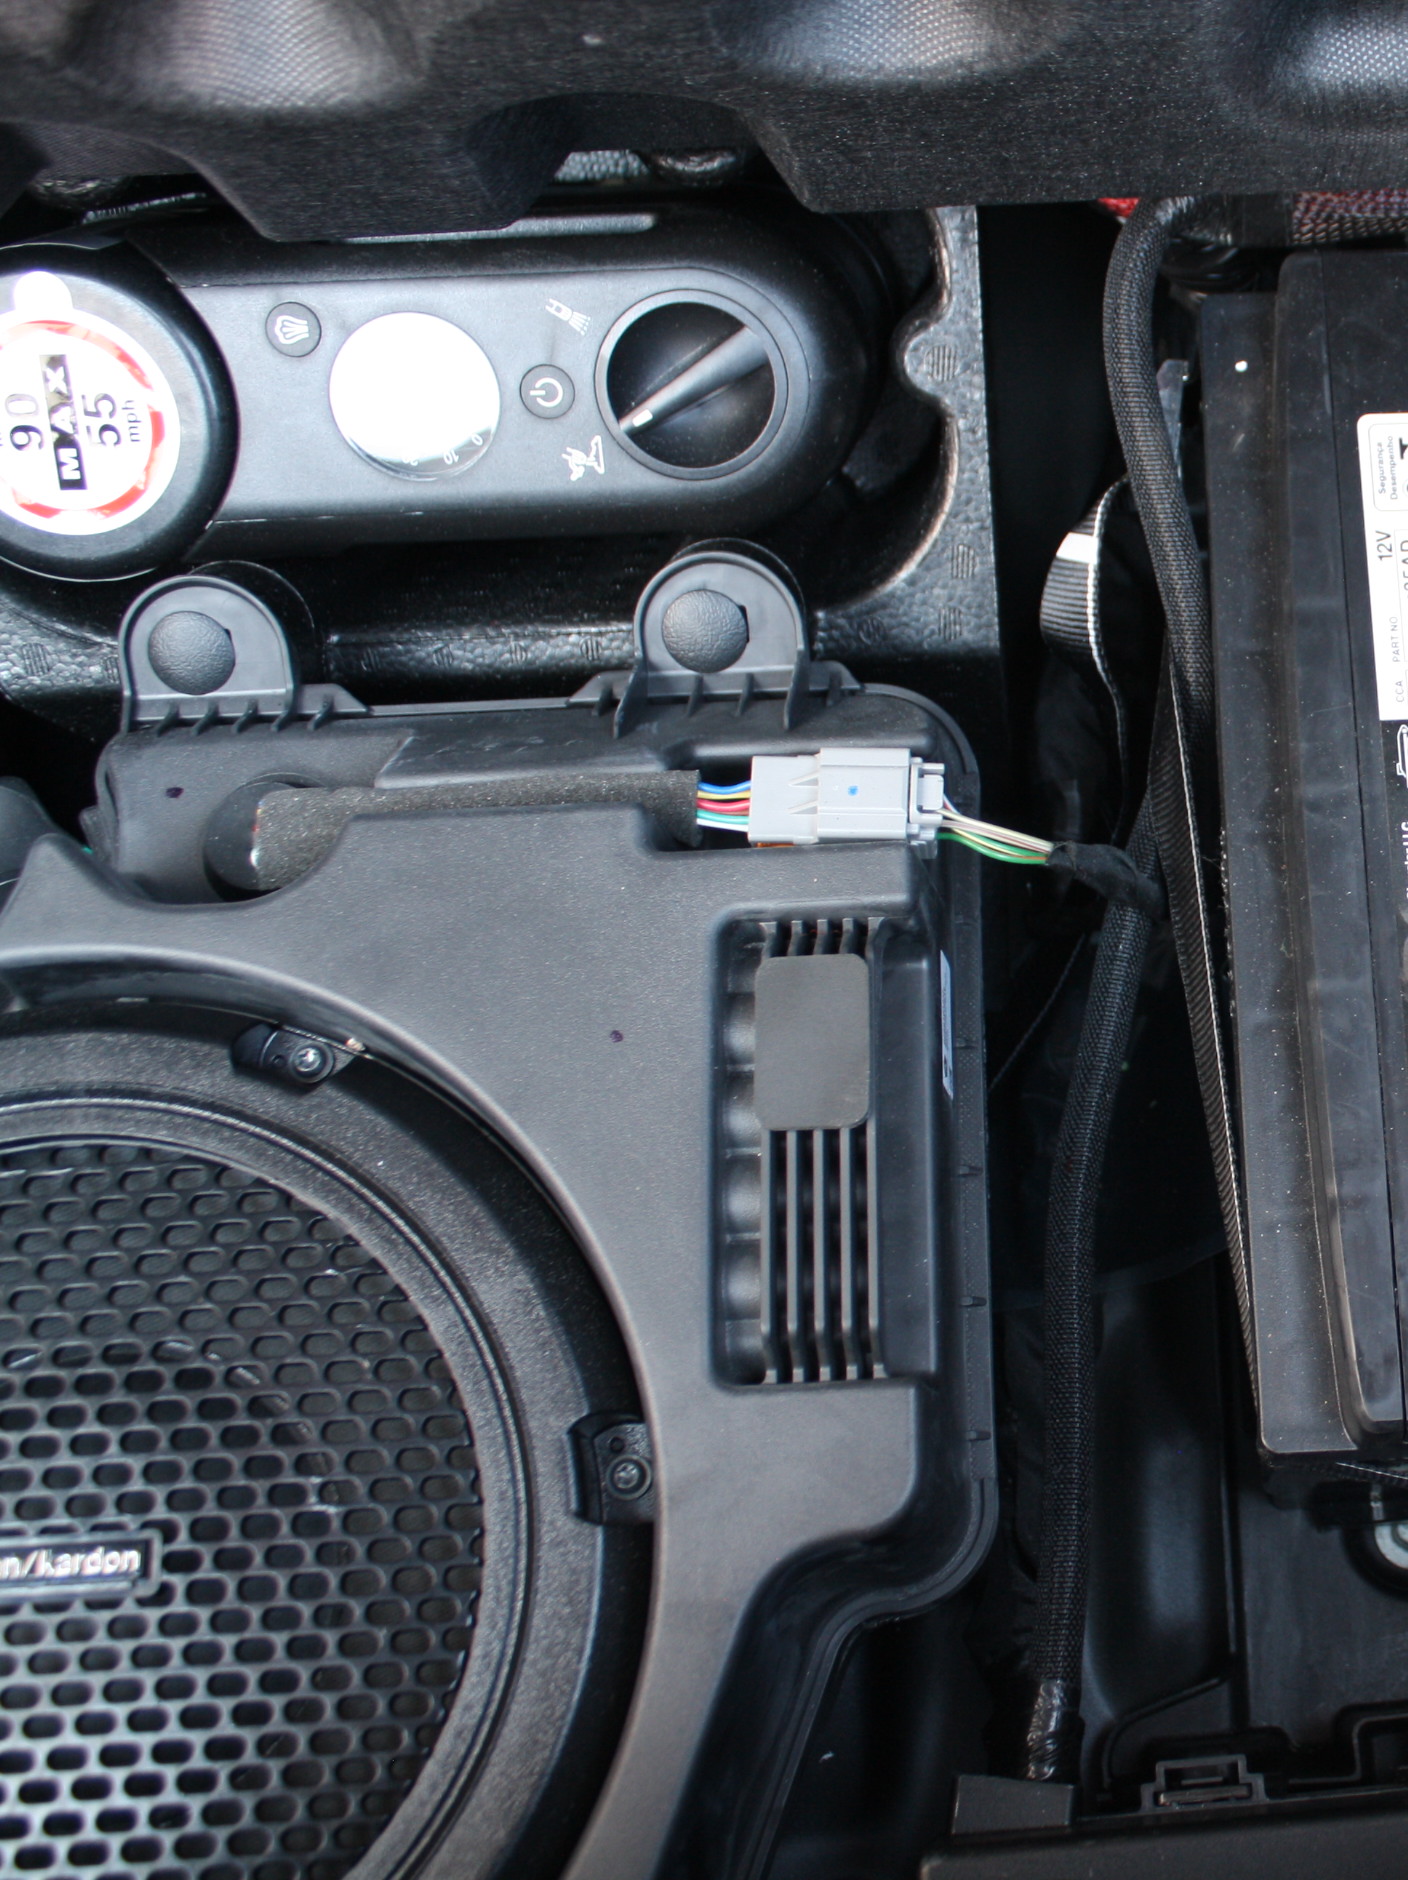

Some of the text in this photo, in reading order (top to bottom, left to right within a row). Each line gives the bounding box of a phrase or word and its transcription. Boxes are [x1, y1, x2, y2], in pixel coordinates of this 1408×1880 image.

[5, 393, 45, 452] 90
[45, 364, 83, 481] MAX
[81, 392, 122, 448] 55
[121, 400, 142, 443] mph
[1377, 442, 1386, 493] Segurança
[1387, 436, 1397, 499] Desempenho
[1375, 530, 1392, 560] 12V
[1390, 617, 1399, 662] PART NO
[1395, 680, 1404, 702] CCA
